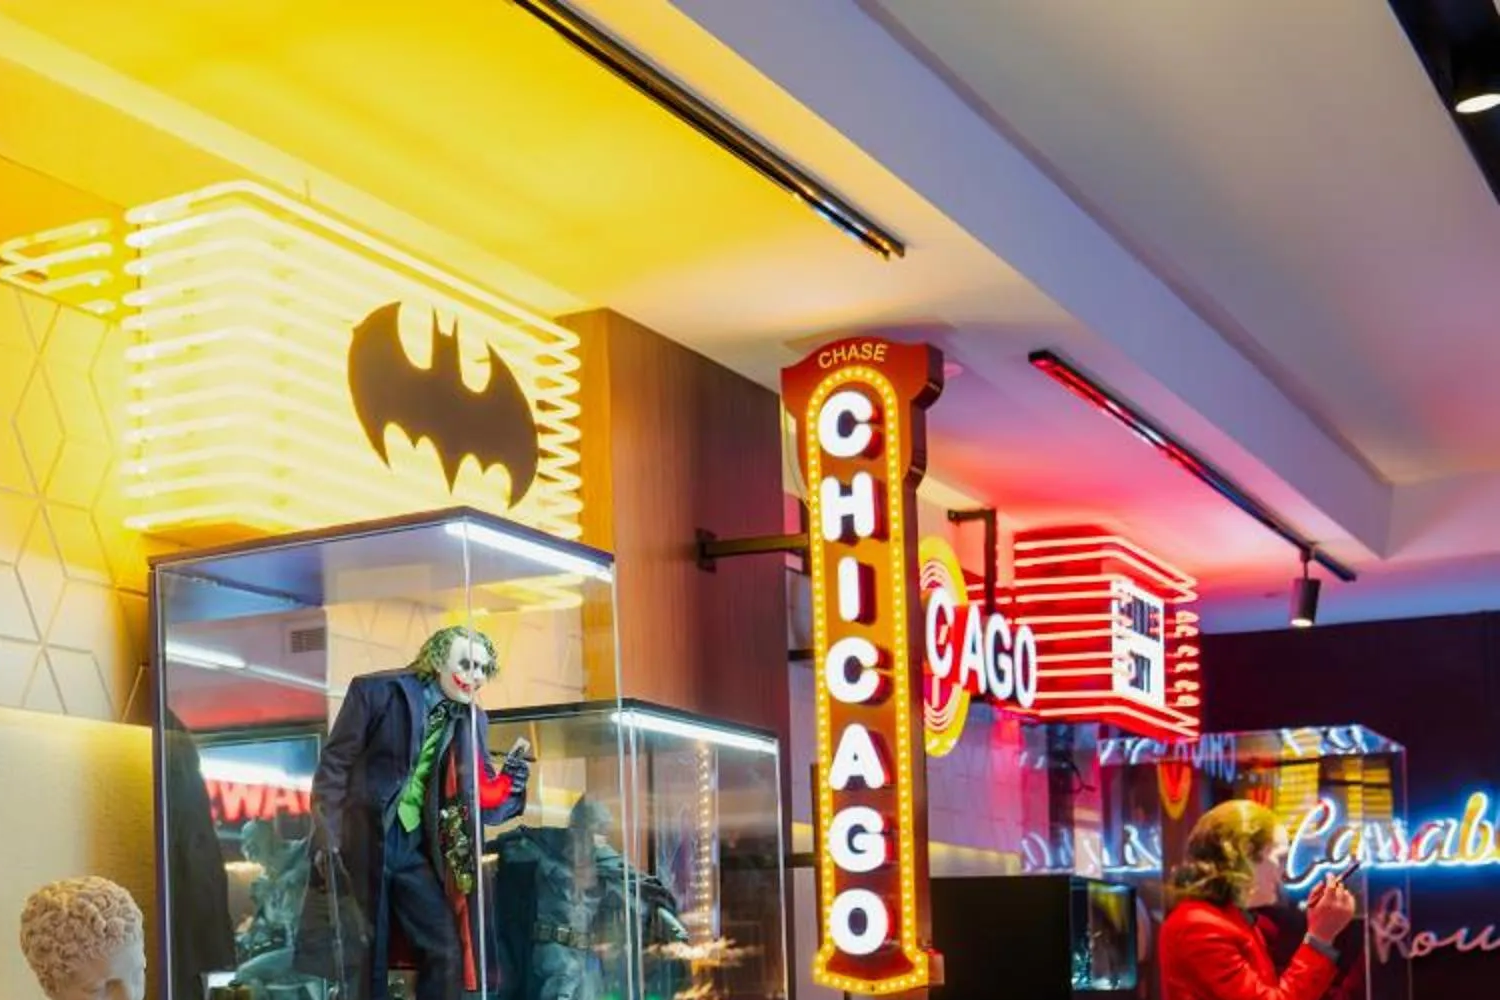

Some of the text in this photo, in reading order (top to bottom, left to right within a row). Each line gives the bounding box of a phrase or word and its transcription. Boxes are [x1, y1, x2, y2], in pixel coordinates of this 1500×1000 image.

[817, 342, 889, 369] CHASE
[817, 390, 890, 956] CHICAGO
[1282, 791, 1500, 889] Casab
